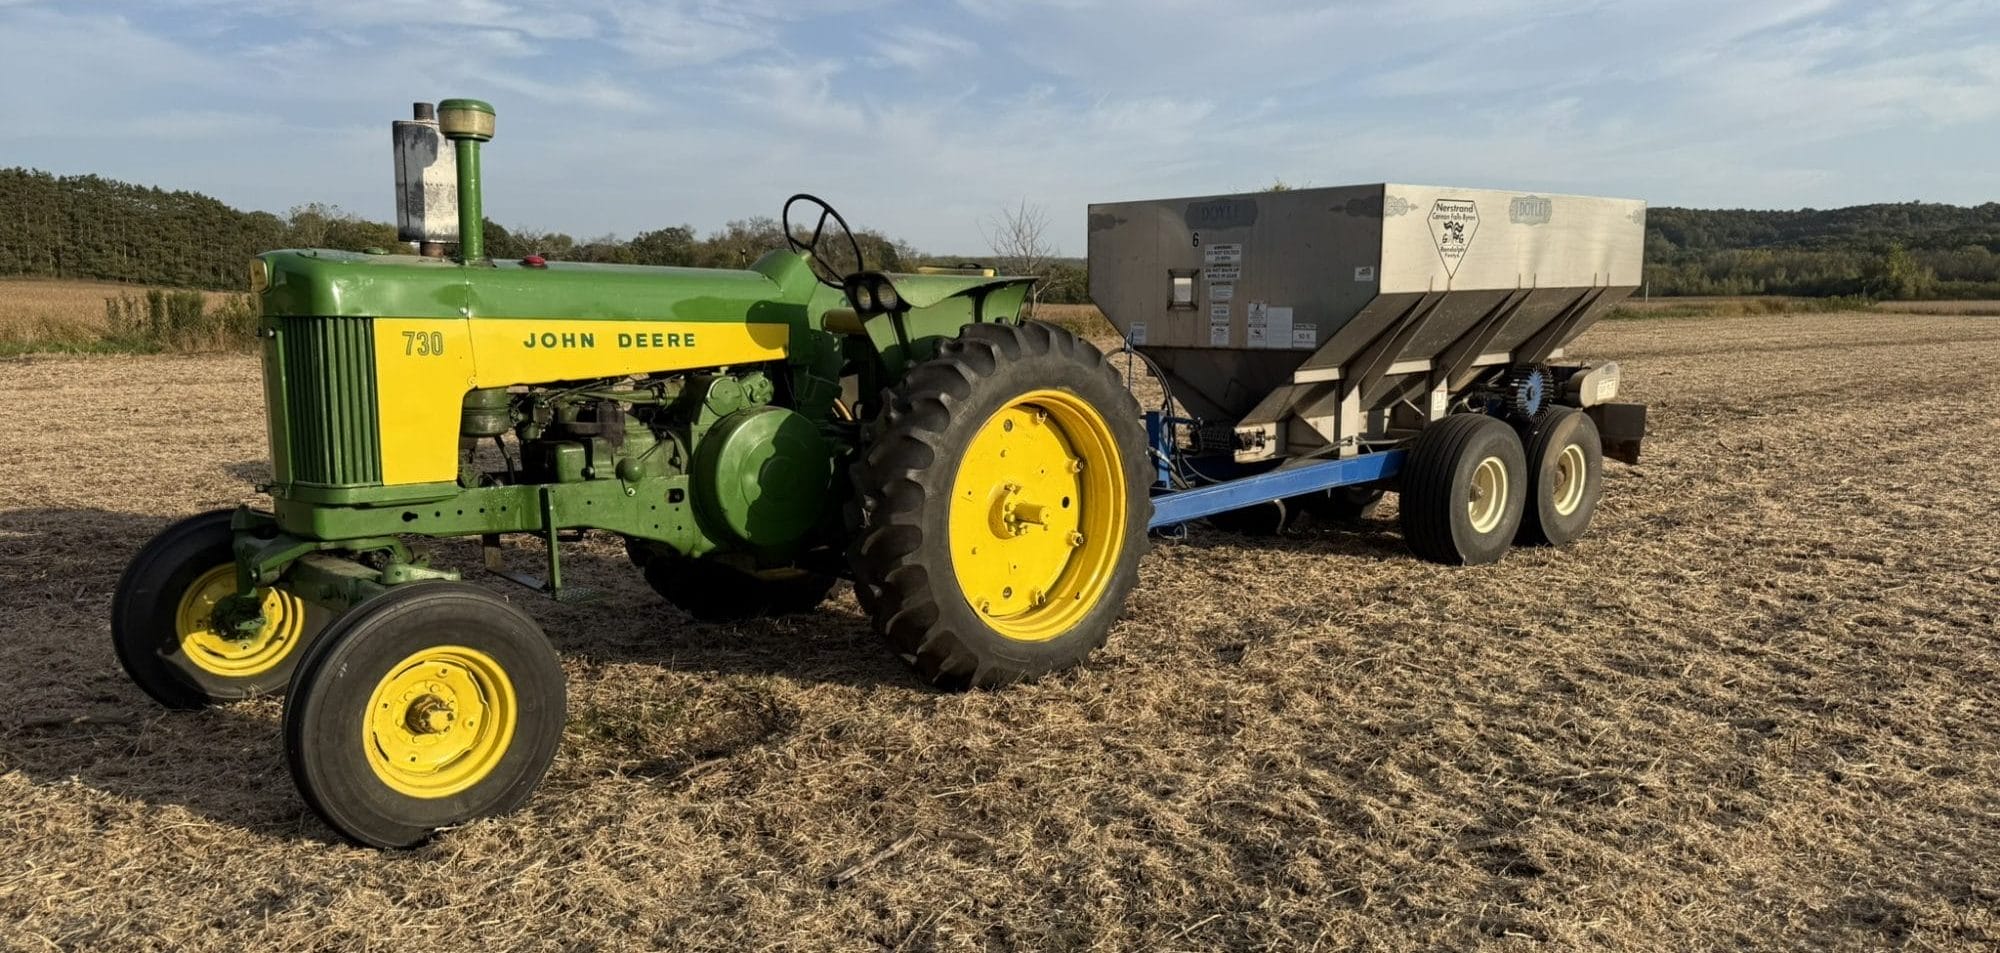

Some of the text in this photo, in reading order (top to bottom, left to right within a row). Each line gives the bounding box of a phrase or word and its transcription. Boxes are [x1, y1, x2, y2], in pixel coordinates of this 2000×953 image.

[1436, 203, 1474, 213] Nerstrand
[1519, 201, 1543, 216] DOYLE
[1432, 212, 1450, 220] Cannon
[1450, 212, 1462, 221] Falls
[1192, 232, 1199, 248] 6
[401, 331, 443, 356] 730
[523, 332, 696, 349] JOHN DEERE
